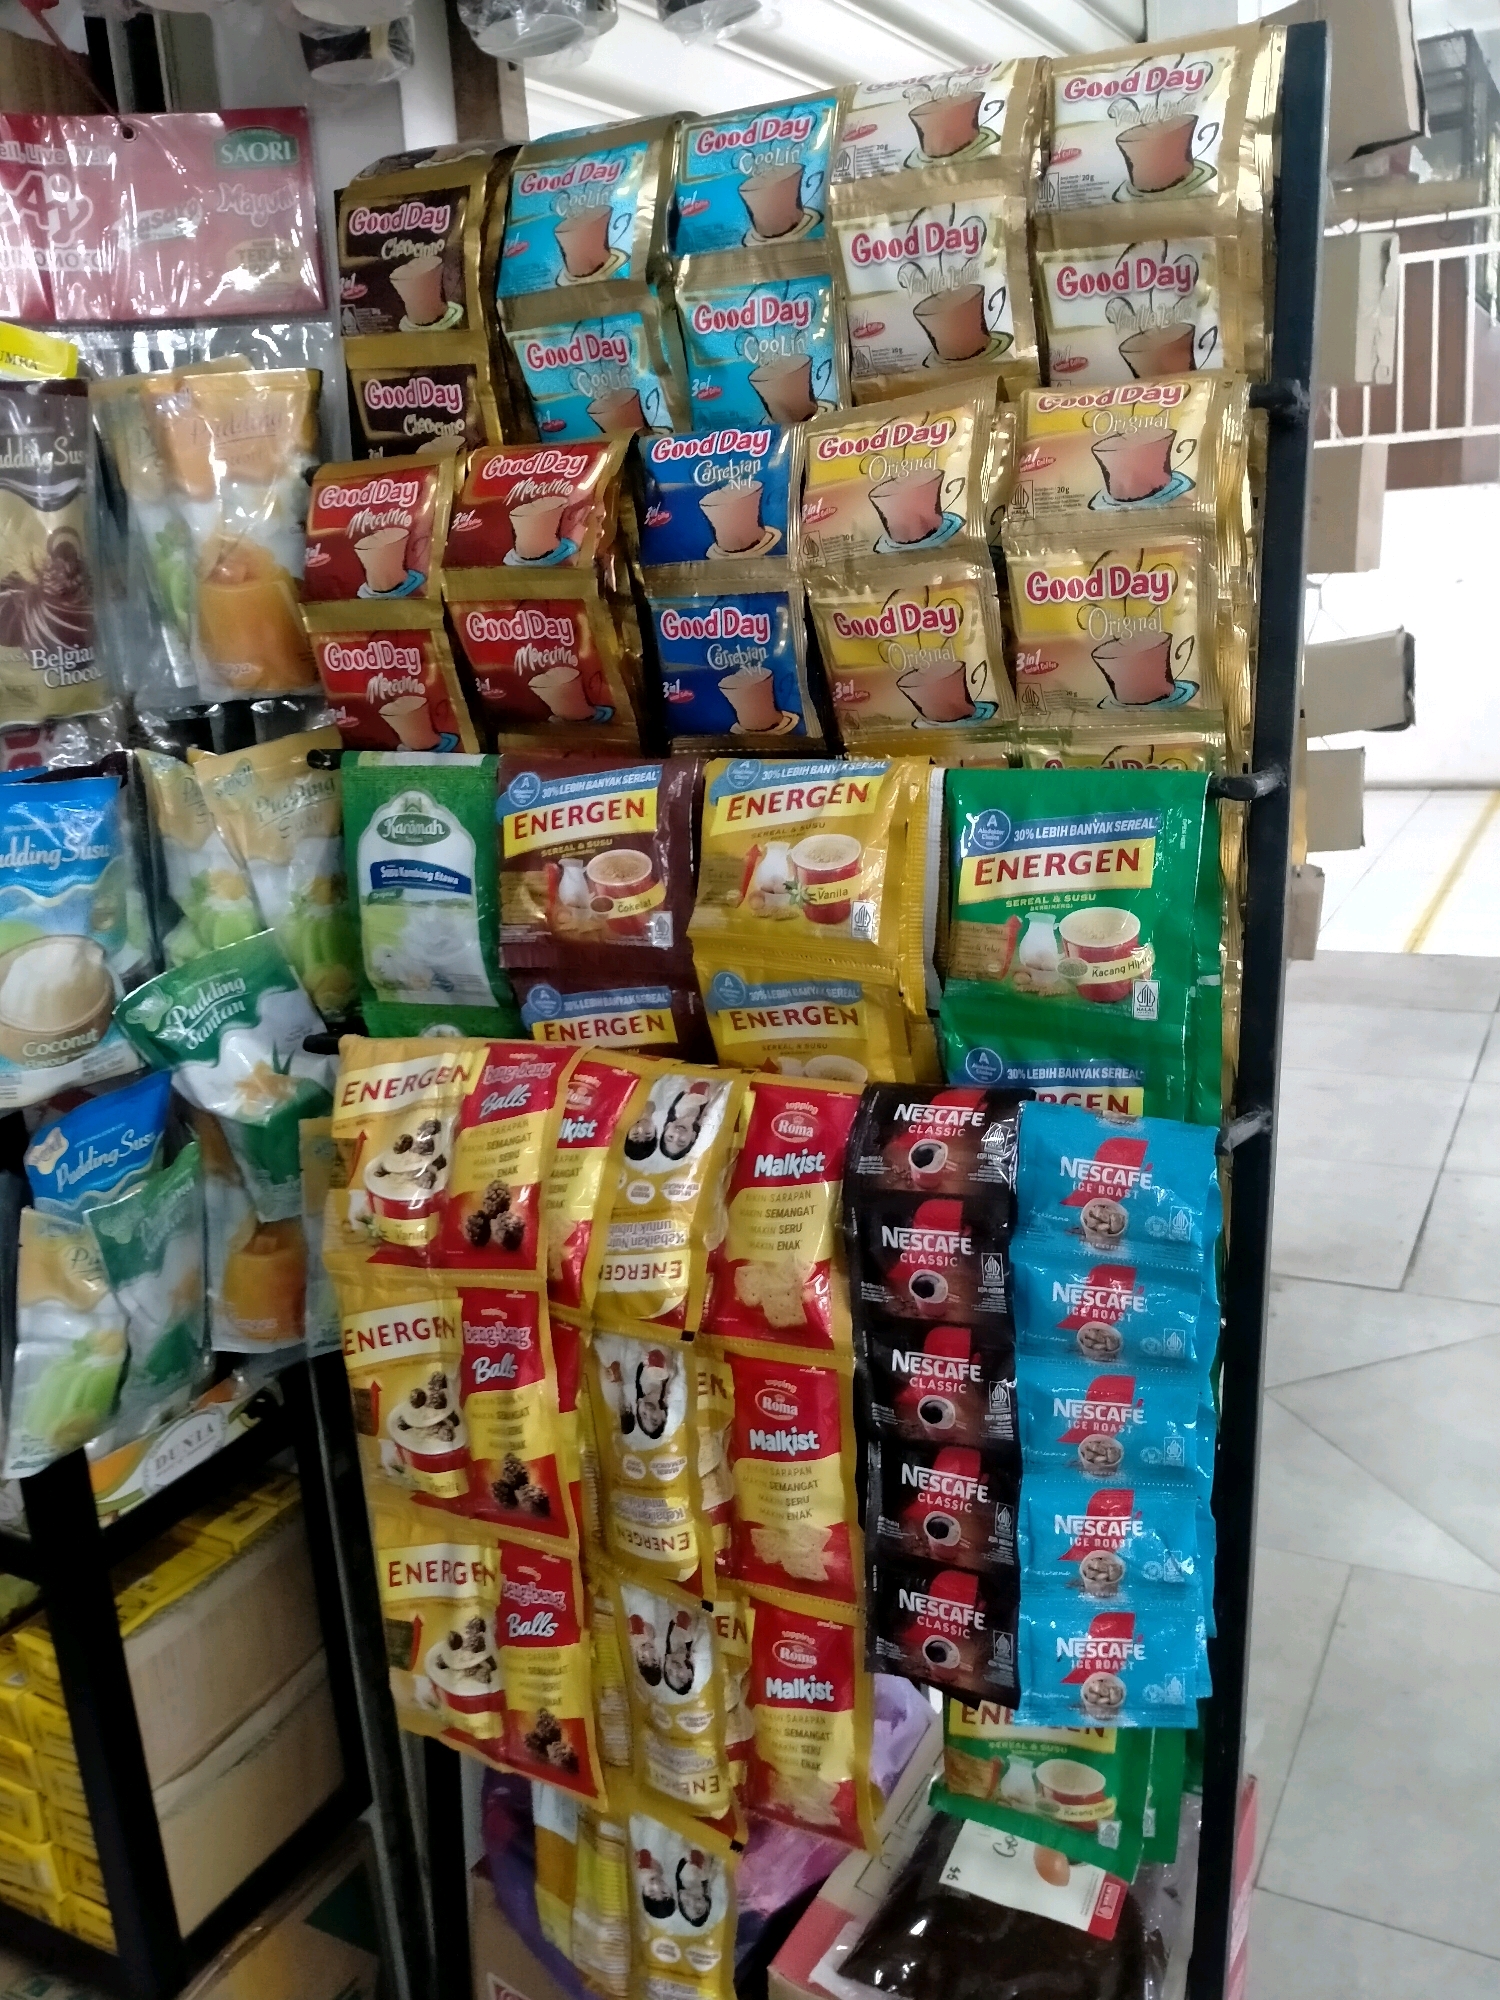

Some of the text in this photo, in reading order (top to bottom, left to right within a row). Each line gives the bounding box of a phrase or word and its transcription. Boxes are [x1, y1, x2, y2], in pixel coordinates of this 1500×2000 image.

[1064, 67, 1207, 100] Good Day
[696, 115, 811, 154] Good Day
[221, 140, 292, 164] SAORI
[520, 161, 623, 195] Good Day
[350, 202, 450, 235] Good Day
[851, 222, 982, 265] Good Day
[1056, 258, 1194, 297] Good Day
[694, 295, 812, 333] Good Day
[526, 334, 630, 371] Good Day
[365, 377, 463, 413] Good Day
[1036, 382, 1186, 413] Good Day
[1092, 408, 1171, 437] Original
[651, 428, 771, 462] Good Day
[816, 419, 951, 461] Good Day
[483, 450, 588, 480] Good Day
[869, 454, 939, 483] Original
[319, 478, 418, 509] Good Day
[1025, 565, 1174, 605] Good Day
[467, 609, 575, 646] Good Day
[660, 607, 770, 643] Good Day
[832, 603, 960, 638] Good Day
[1088, 606, 1164, 641] Original
[324, 641, 422, 673] Good Day
[888, 641, 957, 673] Original
[559, 780, 585, 796] LEBIH
[586, 775, 621, 791] BANYAK
[762, 768, 780, 779] 30%
[781, 766, 810, 778] LEBIH
[726, 781, 871, 823] ENERGEN
[514, 796, 647, 840] ENERGEN
[1014, 828, 1035, 842] 30%
[1035, 825, 1068, 839] LEBIH
[1069, 821, 1113, 837] BANYAK
[751, 828, 788, 839] SEREAL
[0, 837, 62, 870] udding
[974, 847, 1141, 886] ENERGEN
[816, 886, 849, 901] Vanila
[1005, 896, 1050, 908] SEREAL
[1052, 895, 1062, 903] &
[1065, 893, 1097, 902] SUSU
[1091, 963, 1126, 979] Kacang
[166, 977, 247, 1031] Pudding
[732, 1005, 860, 1032] ENERGEN
[544, 1014, 665, 1042] ENERGEN
[21, 1028, 99, 1058] Coconut
[340, 1064, 471, 1108] ENERGEN
[1007, 1068, 1025, 1080] 30%
[1026, 1067, 1057, 1080] LEBIH
[1058, 1067, 1100, 1080] BANYAK
[558, 1115, 598, 1143] lkist
[777, 1118, 814, 1138] Roma
[908, 1124, 966, 1138] CLASSIC
[56, 1146, 119, 1191] Pudding
[754, 1148, 826, 1179] Malkist
[1060, 1155, 1153, 1190] NESCAFÉ
[770, 1189, 812, 1202] SARAPAN
[1094, 1185, 1140, 1200] ROAST
[765, 1204, 815, 1219] SEMANGAT
[779, 1222, 803, 1235] SERU
[777, 1240, 801, 1251] ENAK
[900, 1252, 959, 1268] CLASSIC
[1052, 1281, 1145, 1313] NESCAFÉ
[1092, 1308, 1132, 1323] ROAST
[343, 1315, 456, 1357] ENERGEN
[471, 1352, 519, 1384] Balls
[909, 1376, 967, 1394] CLASSIC
[762, 1395, 799, 1416] Roma
[1053, 1397, 1147, 1425] NESCAFÉ
[749, 1425, 821, 1456] Malkist
[1091, 1421, 1134, 1435] ROAST
[917, 1491, 973, 1514] CLASSIC
[1054, 1511, 1144, 1537] NESCAFÉ
[1092, 1536, 1134, 1549] ROAST
[387, 1560, 496, 1588] ENERGEN
[505, 1612, 559, 1638] Balls
[916, 1615, 971, 1640] CLASSIC
[779, 1646, 818, 1667] Roma
[1056, 1634, 1146, 1661] NESCAFÉ
[1092, 1659, 1135, 1672] ROAST
[765, 1674, 835, 1704] Malkist
